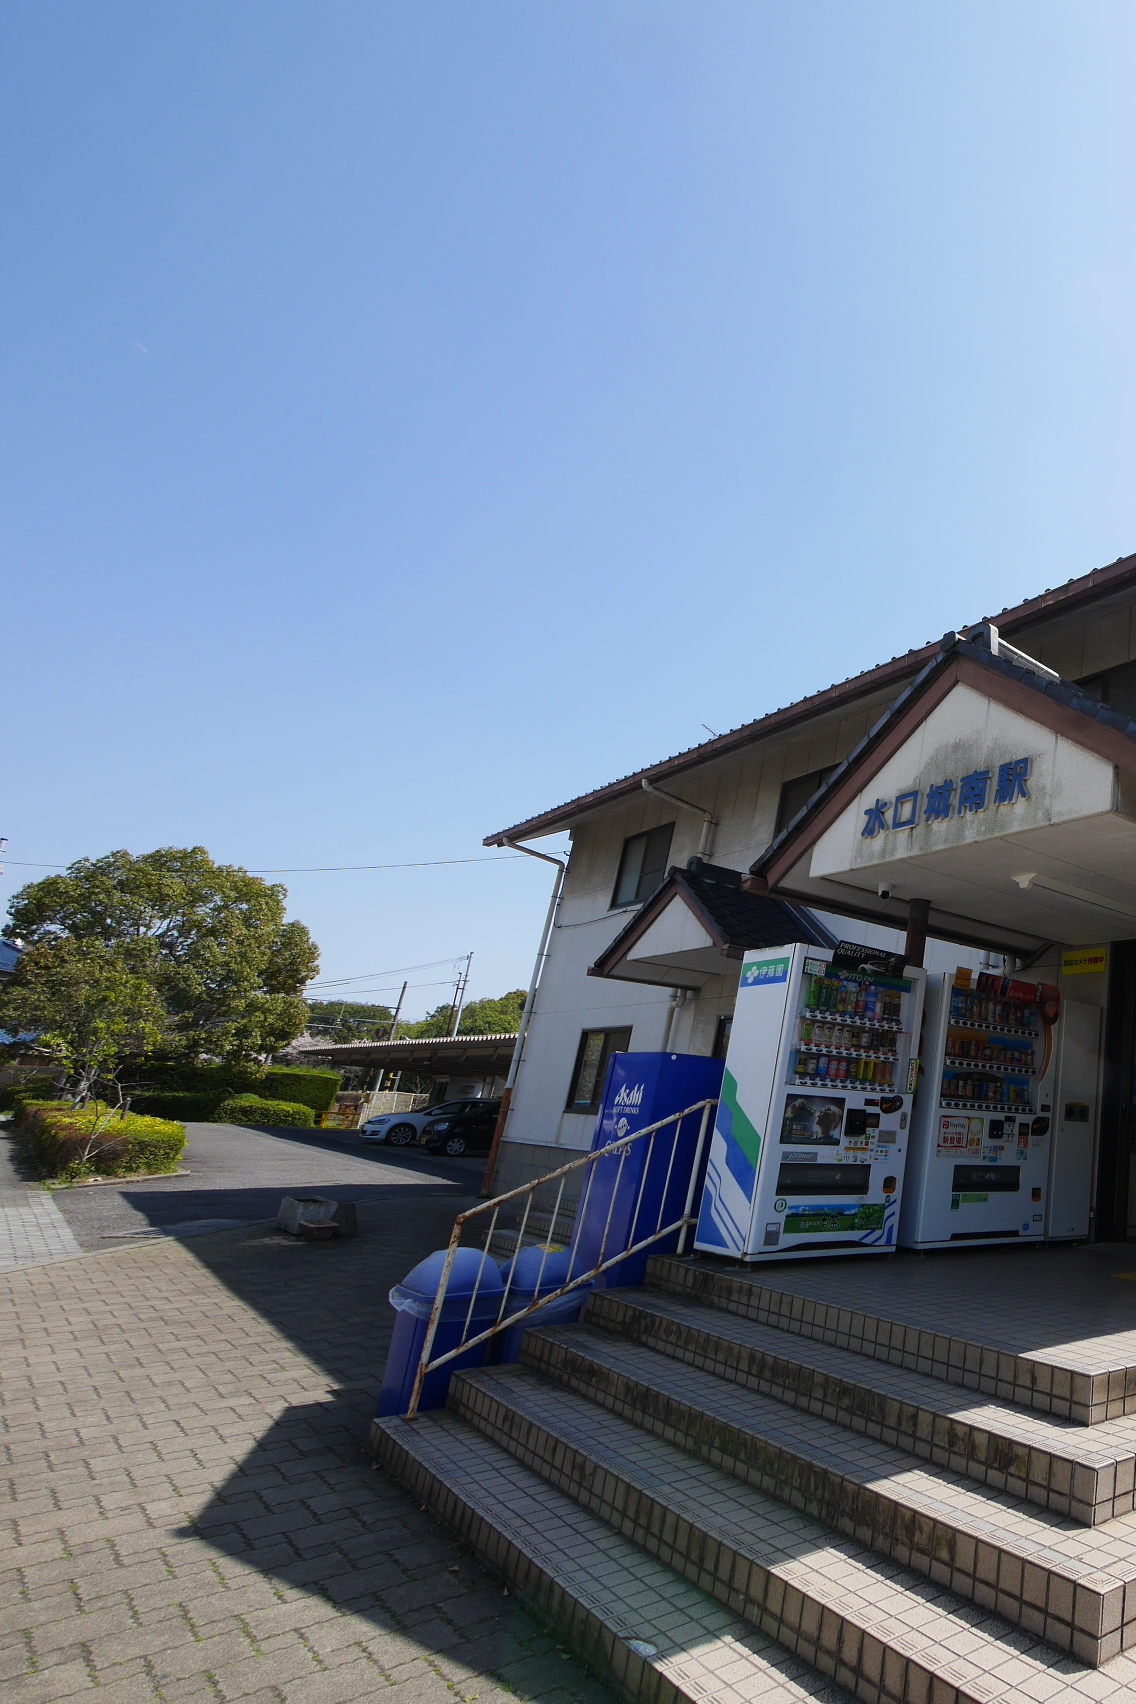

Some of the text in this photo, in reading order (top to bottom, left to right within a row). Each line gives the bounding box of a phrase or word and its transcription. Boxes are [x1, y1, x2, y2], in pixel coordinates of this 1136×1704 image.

[861, 757, 1031, 839] 水口城南駅
[837, 948, 867, 959] QUALITY
[840, 942, 887, 958] PROFESSIONAL
[759, 964, 784, 979] 伊藤園
[848, 973, 875, 983] ITO EN
[614, 1083, 645, 1107] Asahi
[613, 1106, 640, 1115] SOFT DRINKS
[949, 1122, 967, 1130] PayPay
[605, 1140, 632, 1157] CLPS
